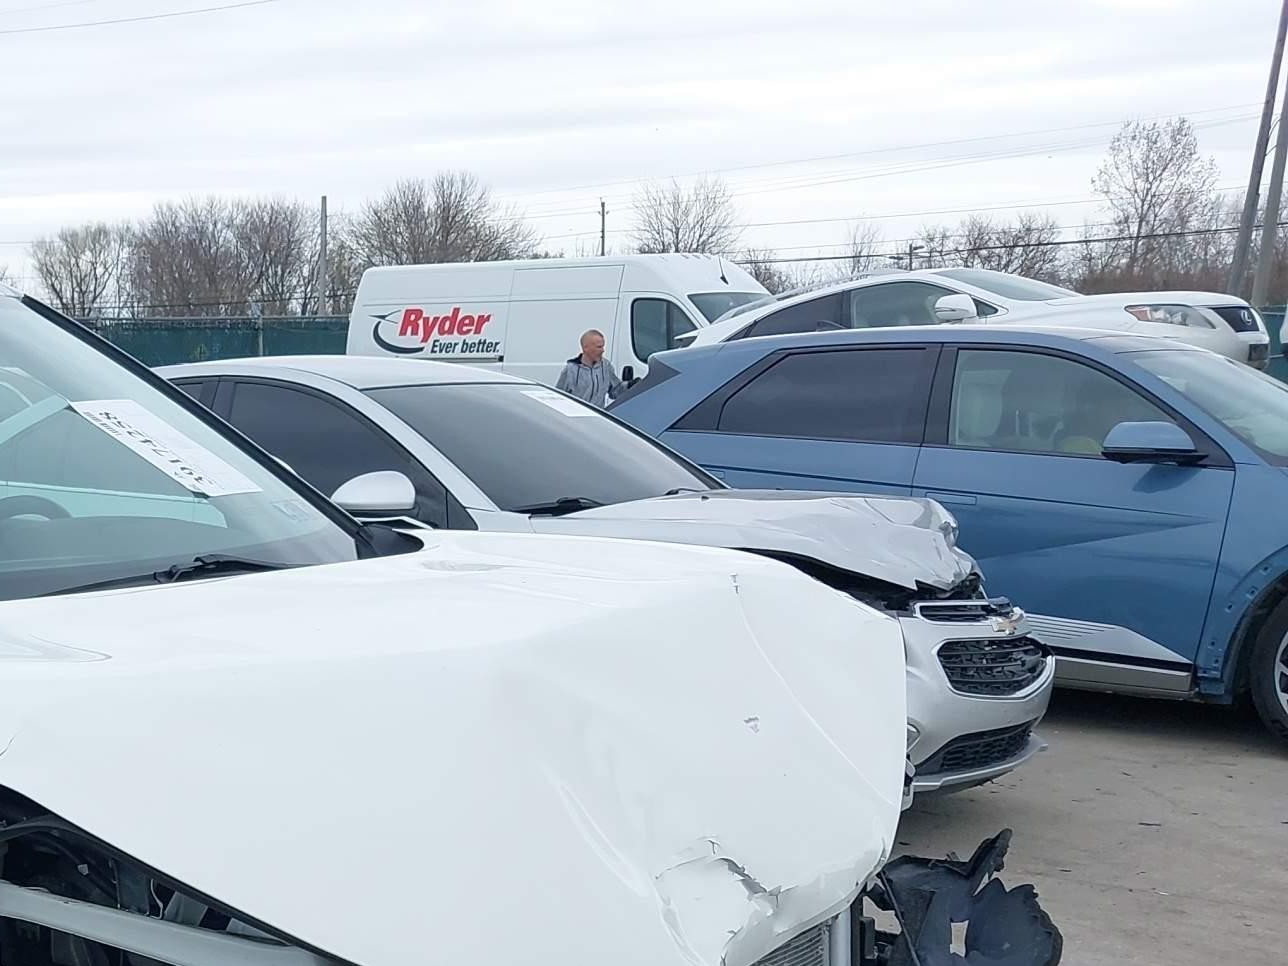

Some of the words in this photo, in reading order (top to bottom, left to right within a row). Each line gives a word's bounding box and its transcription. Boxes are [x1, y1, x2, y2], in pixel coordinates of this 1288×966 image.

[398, 307, 491, 343] Ryder
[430, 340, 459, 354] Ever
[460, 339, 500, 354] better.
